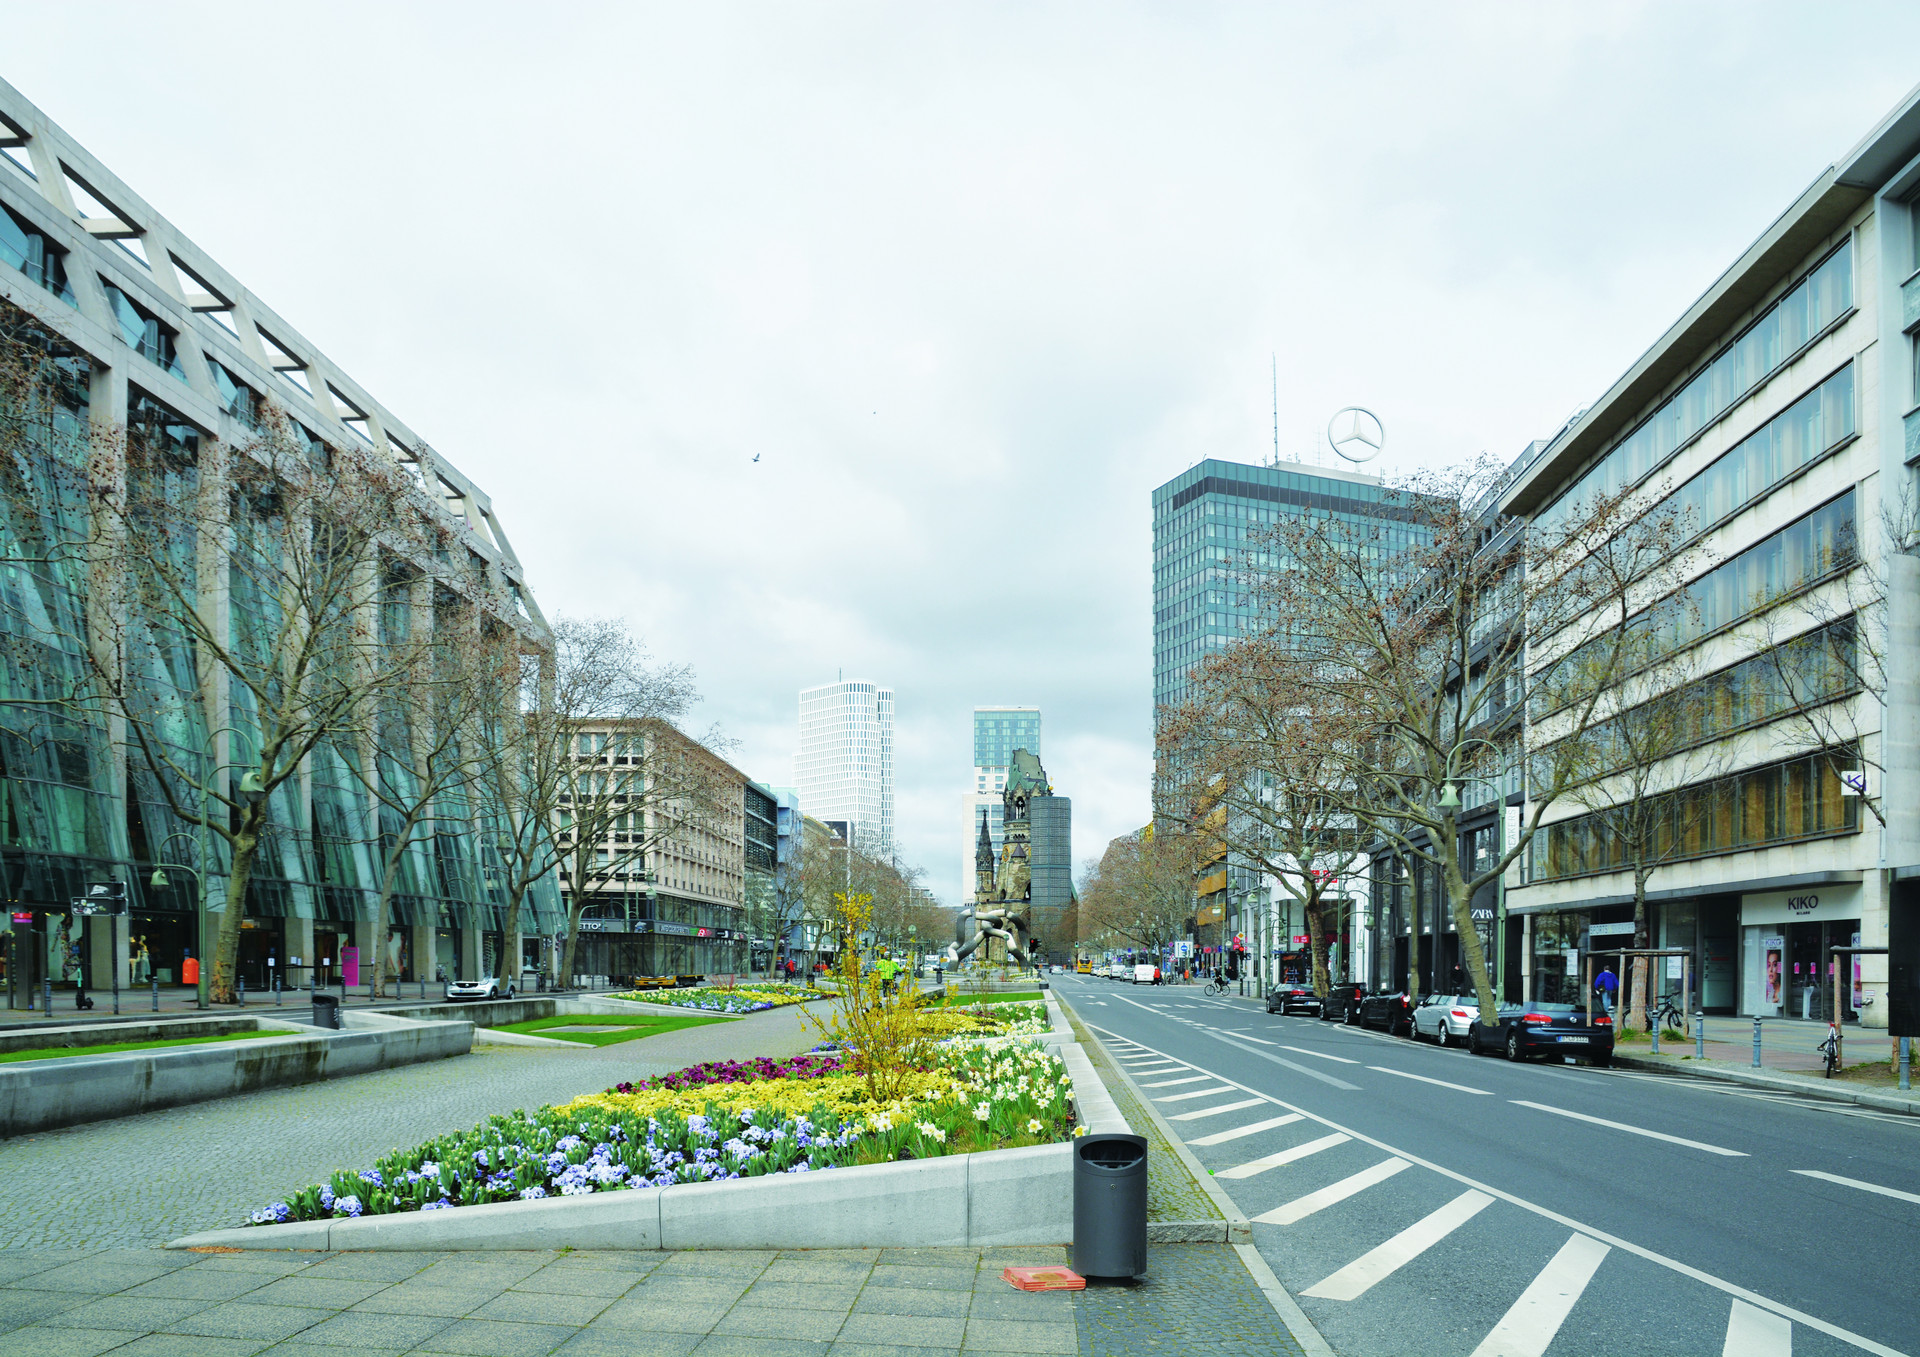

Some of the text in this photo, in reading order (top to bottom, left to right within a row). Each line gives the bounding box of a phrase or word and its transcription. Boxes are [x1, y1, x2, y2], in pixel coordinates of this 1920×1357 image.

[1788, 895, 1819, 911] KIKO
[1471, 909, 1494, 919] ZARA
[1765, 938, 1782, 947] KIKO
